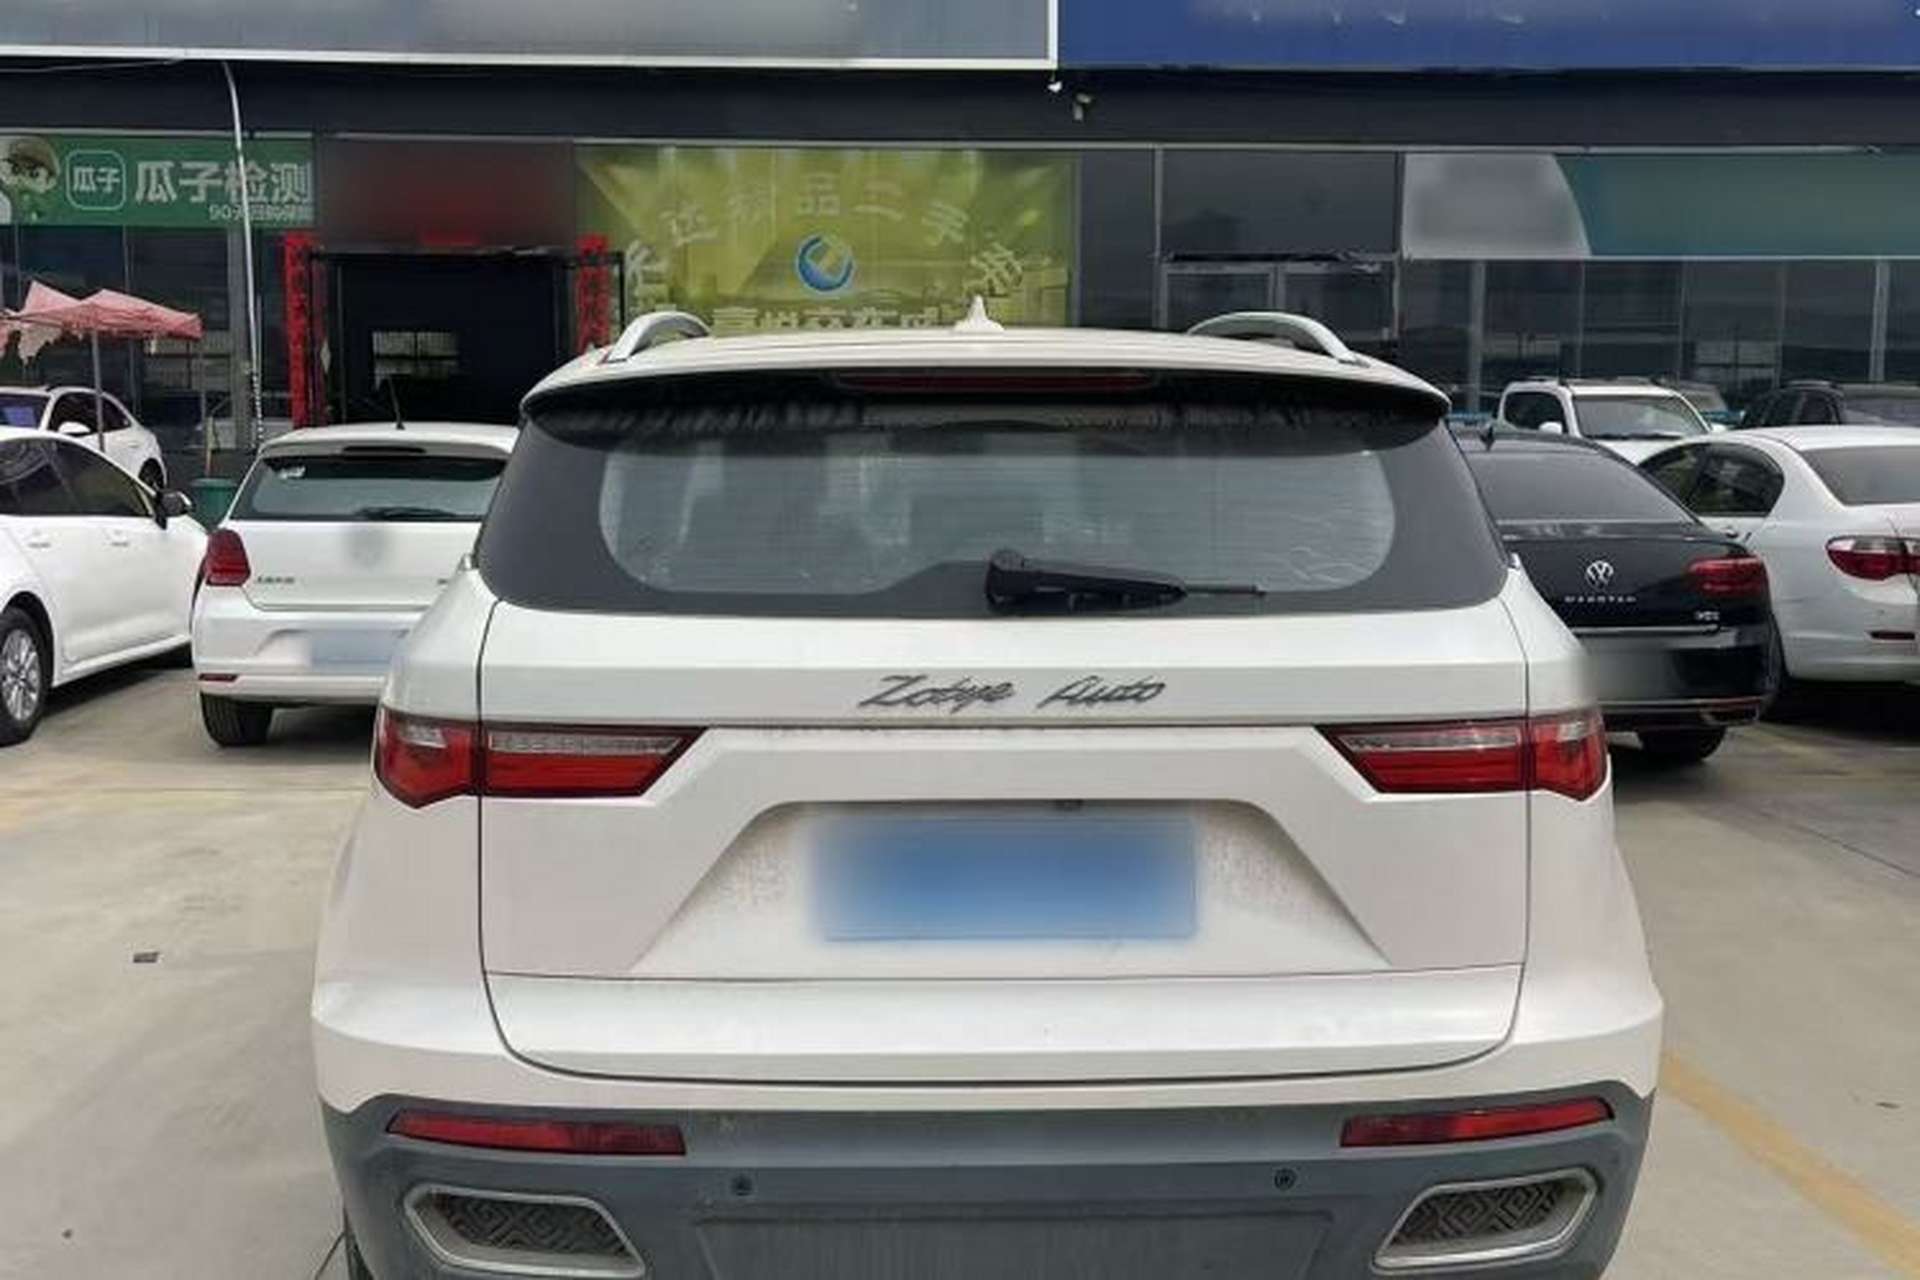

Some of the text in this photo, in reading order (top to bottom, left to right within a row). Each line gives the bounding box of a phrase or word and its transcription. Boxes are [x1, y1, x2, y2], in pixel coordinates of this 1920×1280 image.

[73, 166, 121, 194] 瓜子
[135, 160, 313, 203] 瓜子检测
[857, 674, 1167, 714] Zotye Auto
